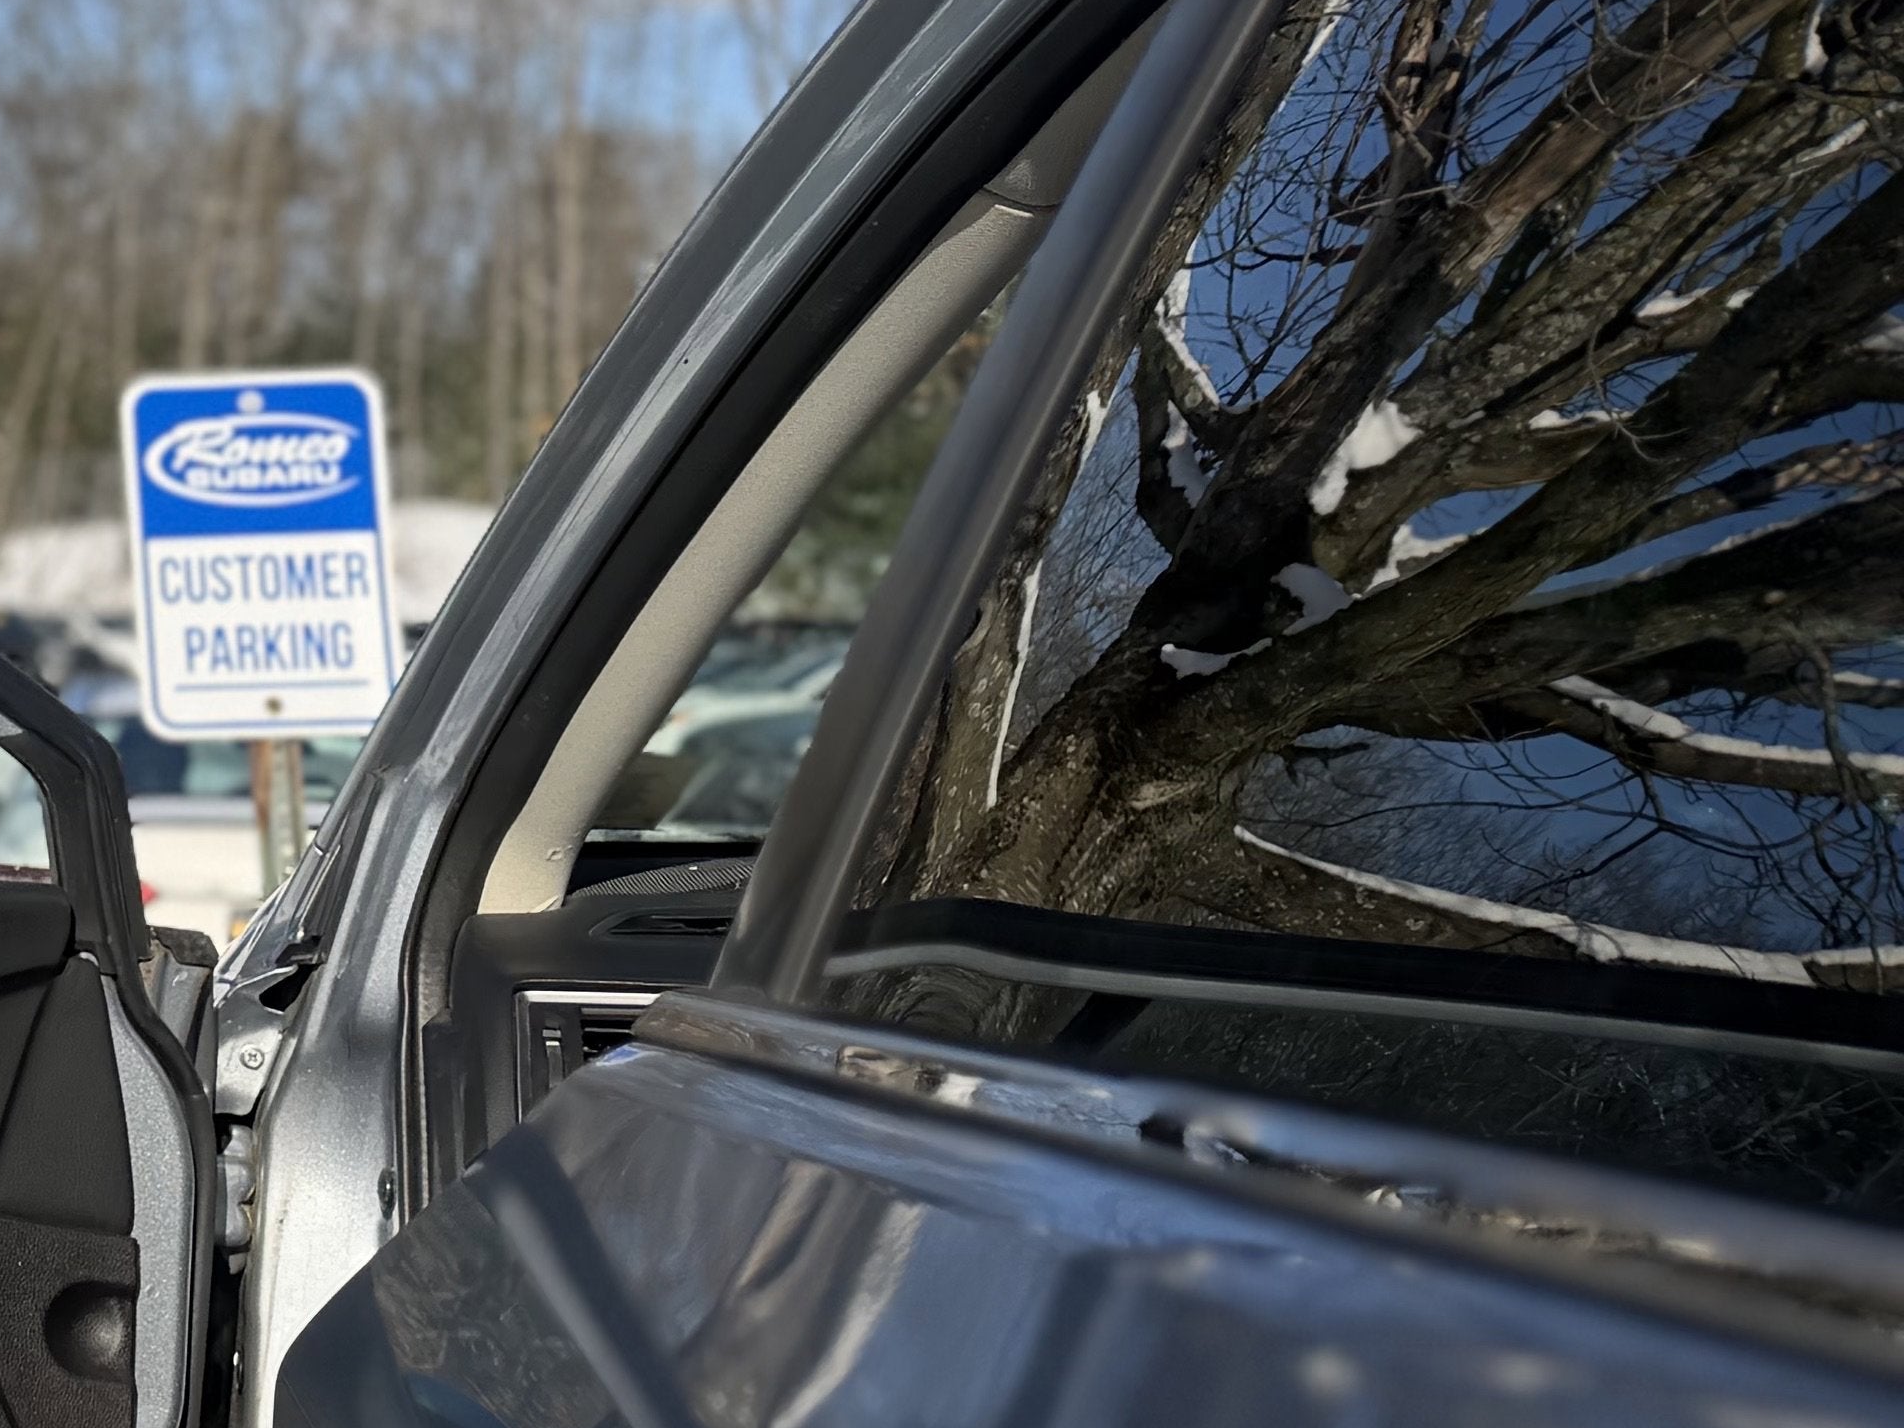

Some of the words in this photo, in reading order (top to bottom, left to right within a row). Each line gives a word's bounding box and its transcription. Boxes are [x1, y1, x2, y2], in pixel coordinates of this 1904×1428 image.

[171, 424, 349, 472] Romeo
[185, 463, 341, 490] SUBARU
[158, 551, 370, 605] CUSTOMER
[185, 622, 355, 673] PARKING
